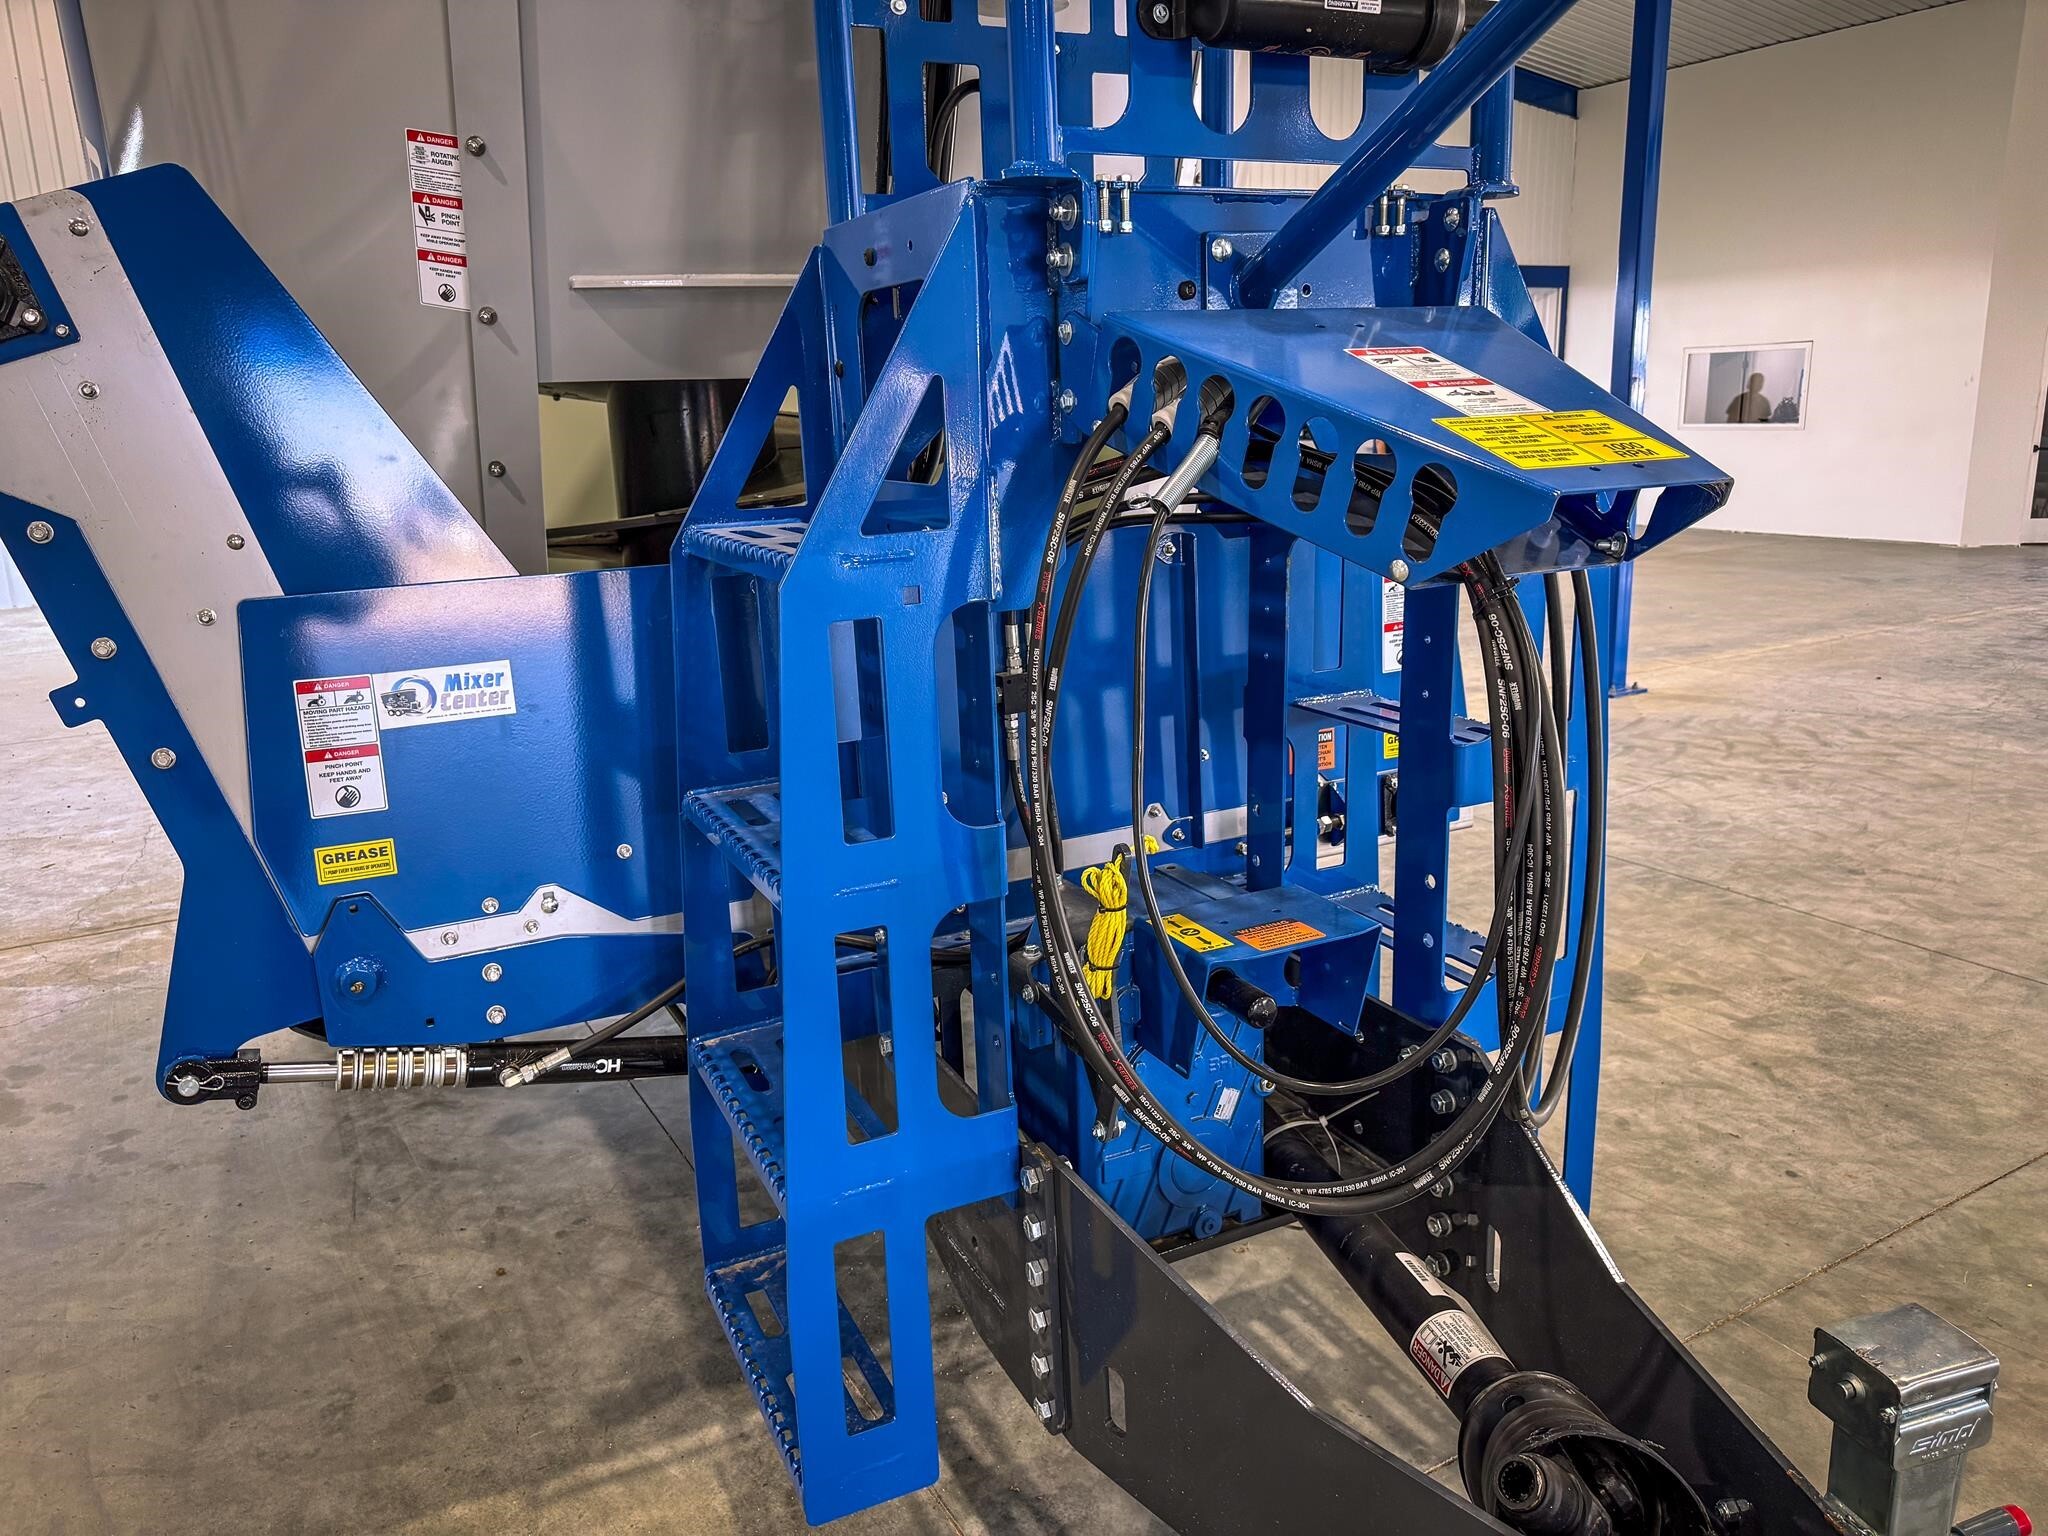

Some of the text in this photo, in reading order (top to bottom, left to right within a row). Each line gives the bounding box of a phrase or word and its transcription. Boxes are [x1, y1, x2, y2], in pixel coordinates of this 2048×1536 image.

[427, 136, 453, 145] DANGER
[432, 158, 453, 166] AUGER
[432, 198, 458, 206] DANGER
[441, 212, 460, 221] PINCH
[442, 219, 460, 227] POINT
[437, 256, 462, 264] DANGER
[1142, 443, 1151, 455] WP
[1602, 441, 1644, 450] 1000
[1613, 448, 1660, 458] RPM
[1130, 454, 1143, 470] 4785
[1105, 494, 1116, 510] BAR
[1093, 511, 1106, 533] MSHA
[1046, 512, 1066, 564] SNF2SC-06
[1084, 532, 1095, 556] IC-304
[1488, 613, 1514, 671] SNF2SC-06
[1031, 648, 1040, 686] ISO11237-1
[443, 672, 504, 692] Mixer
[441, 689, 510, 711] Center
[1030, 691, 1038, 706] 2SC
[345, 705, 371, 713] HAZARD
[1497, 679, 1510, 738] SNF2SC-06
[1030, 726, 1037, 738] WP
[1032, 783, 1040, 799] BAR
[1034, 802, 1042, 823] MSHA
[1036, 825, 1045, 847] IC-304
[1546, 834, 1552, 846] WP
[322, 846, 389, 865] GREASE
[1526, 872, 1534, 895] MSHA
[1525, 899, 1533, 915] BAR
[1038, 889, 1044, 900] WP
[1045, 938, 1054, 952] BAR
[1523, 915, 1532, 947] PSI/330
[1522, 947, 1530, 966] 4785
[1520, 965, 1528, 978] WP
[1494, 1024, 1521, 1075] SNF2SC-06
[595, 1058, 621, 1073] HC
[1074, 982, 1100, 1028] SNF2SC-06
[1139, 1094, 1167, 1126] ISO11237-1
[1168, 1127, 1181, 1140] 2SC
[1181, 1140, 1195, 1150] 3/8"
[1196, 1151, 1207, 1161] WP
[1207, 1160, 1221, 1173] 4785
[1221, 1169, 1247, 1188] PSI/330
[1247, 1184, 1263, 1195] BAR
[1264, 1192, 1285, 1204] MSHA
[1288, 1199, 1310, 1209] IC-304
[1133, 1107, 1172, 1143] SNF2SC-06
[1318, 1187, 1332, 1195] 4785
[1332, 1184, 1356, 1194] PSI/330
[1355, 1180, 1369, 1190] BAR
[1370, 1174, 1388, 1186] MSHA
[1389, 1165, 1407, 1178] IC-304
[1413, 1341, 1441, 1380] DANGER
